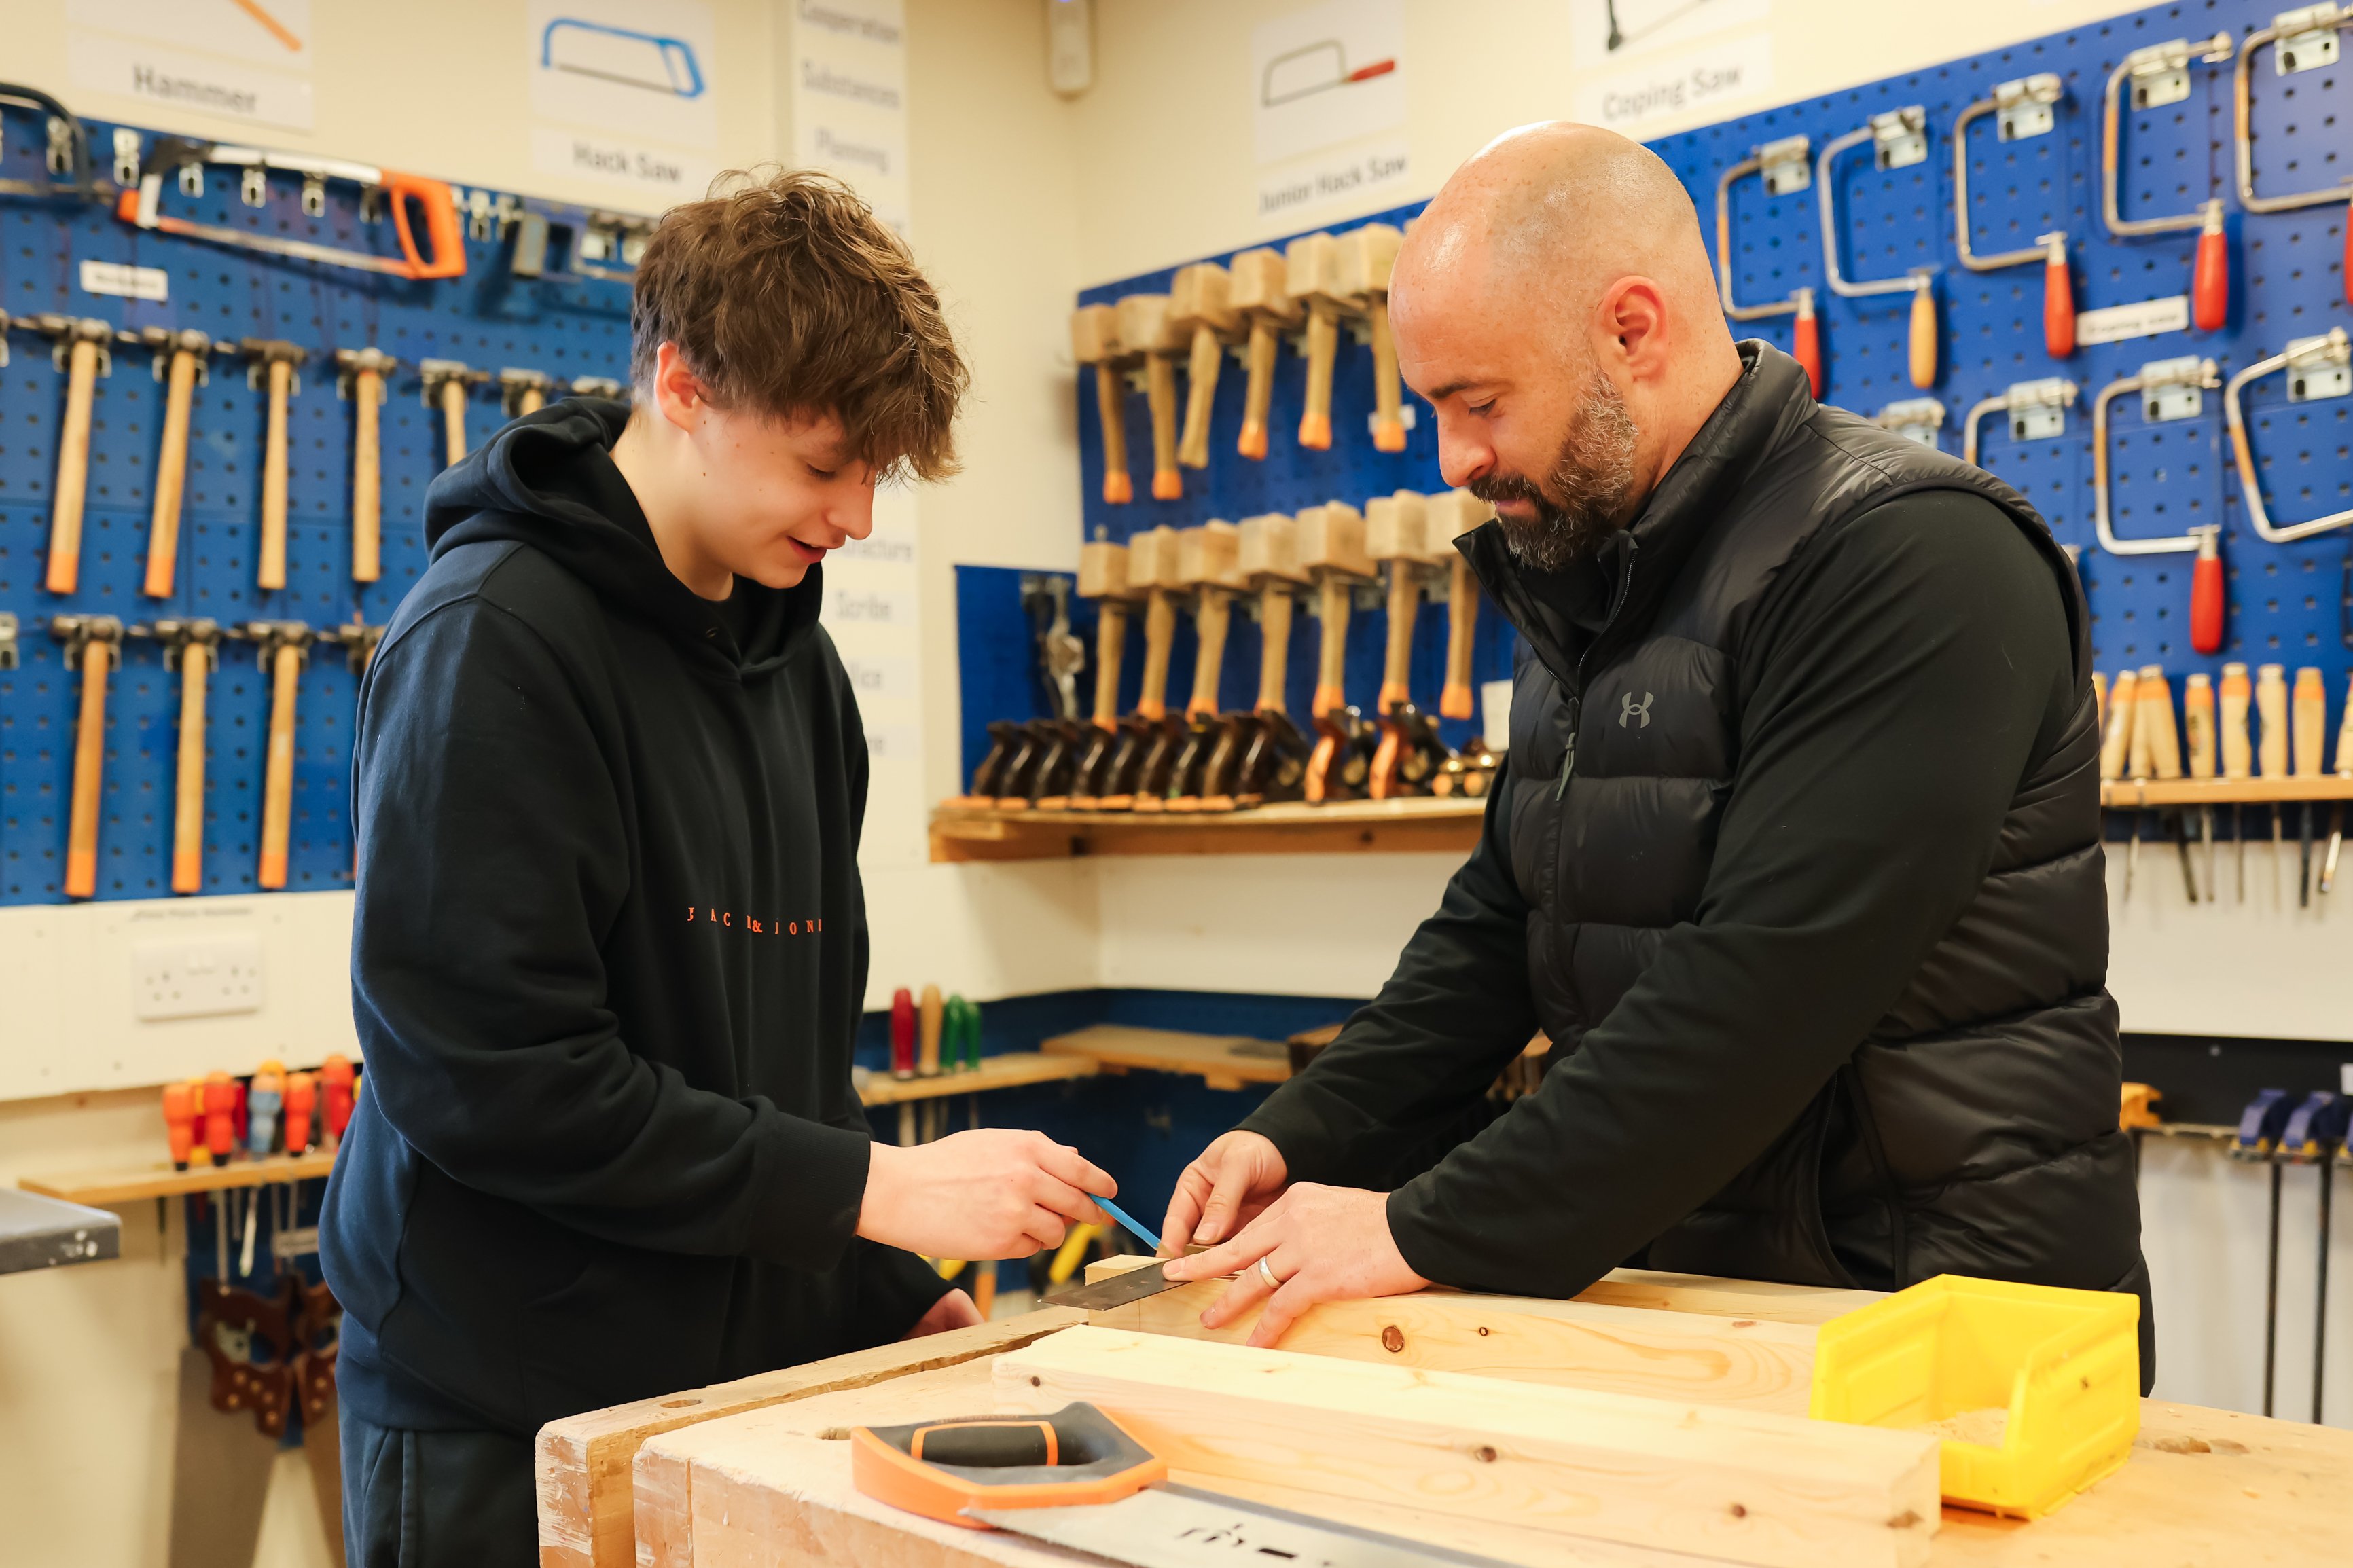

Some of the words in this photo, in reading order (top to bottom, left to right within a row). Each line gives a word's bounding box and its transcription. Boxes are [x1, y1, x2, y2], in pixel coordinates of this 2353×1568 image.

[133, 64, 255, 113] Hammer
[1602, 79, 1685, 122] Coping
[1691, 65, 1743, 98] Saw
[573, 141, 627, 175] Hack
[636, 151, 683, 185] Saw
[1259, 181, 1312, 215] Junior
[1316, 165, 1361, 196] Hack
[1367, 155, 1407, 184] Saw
